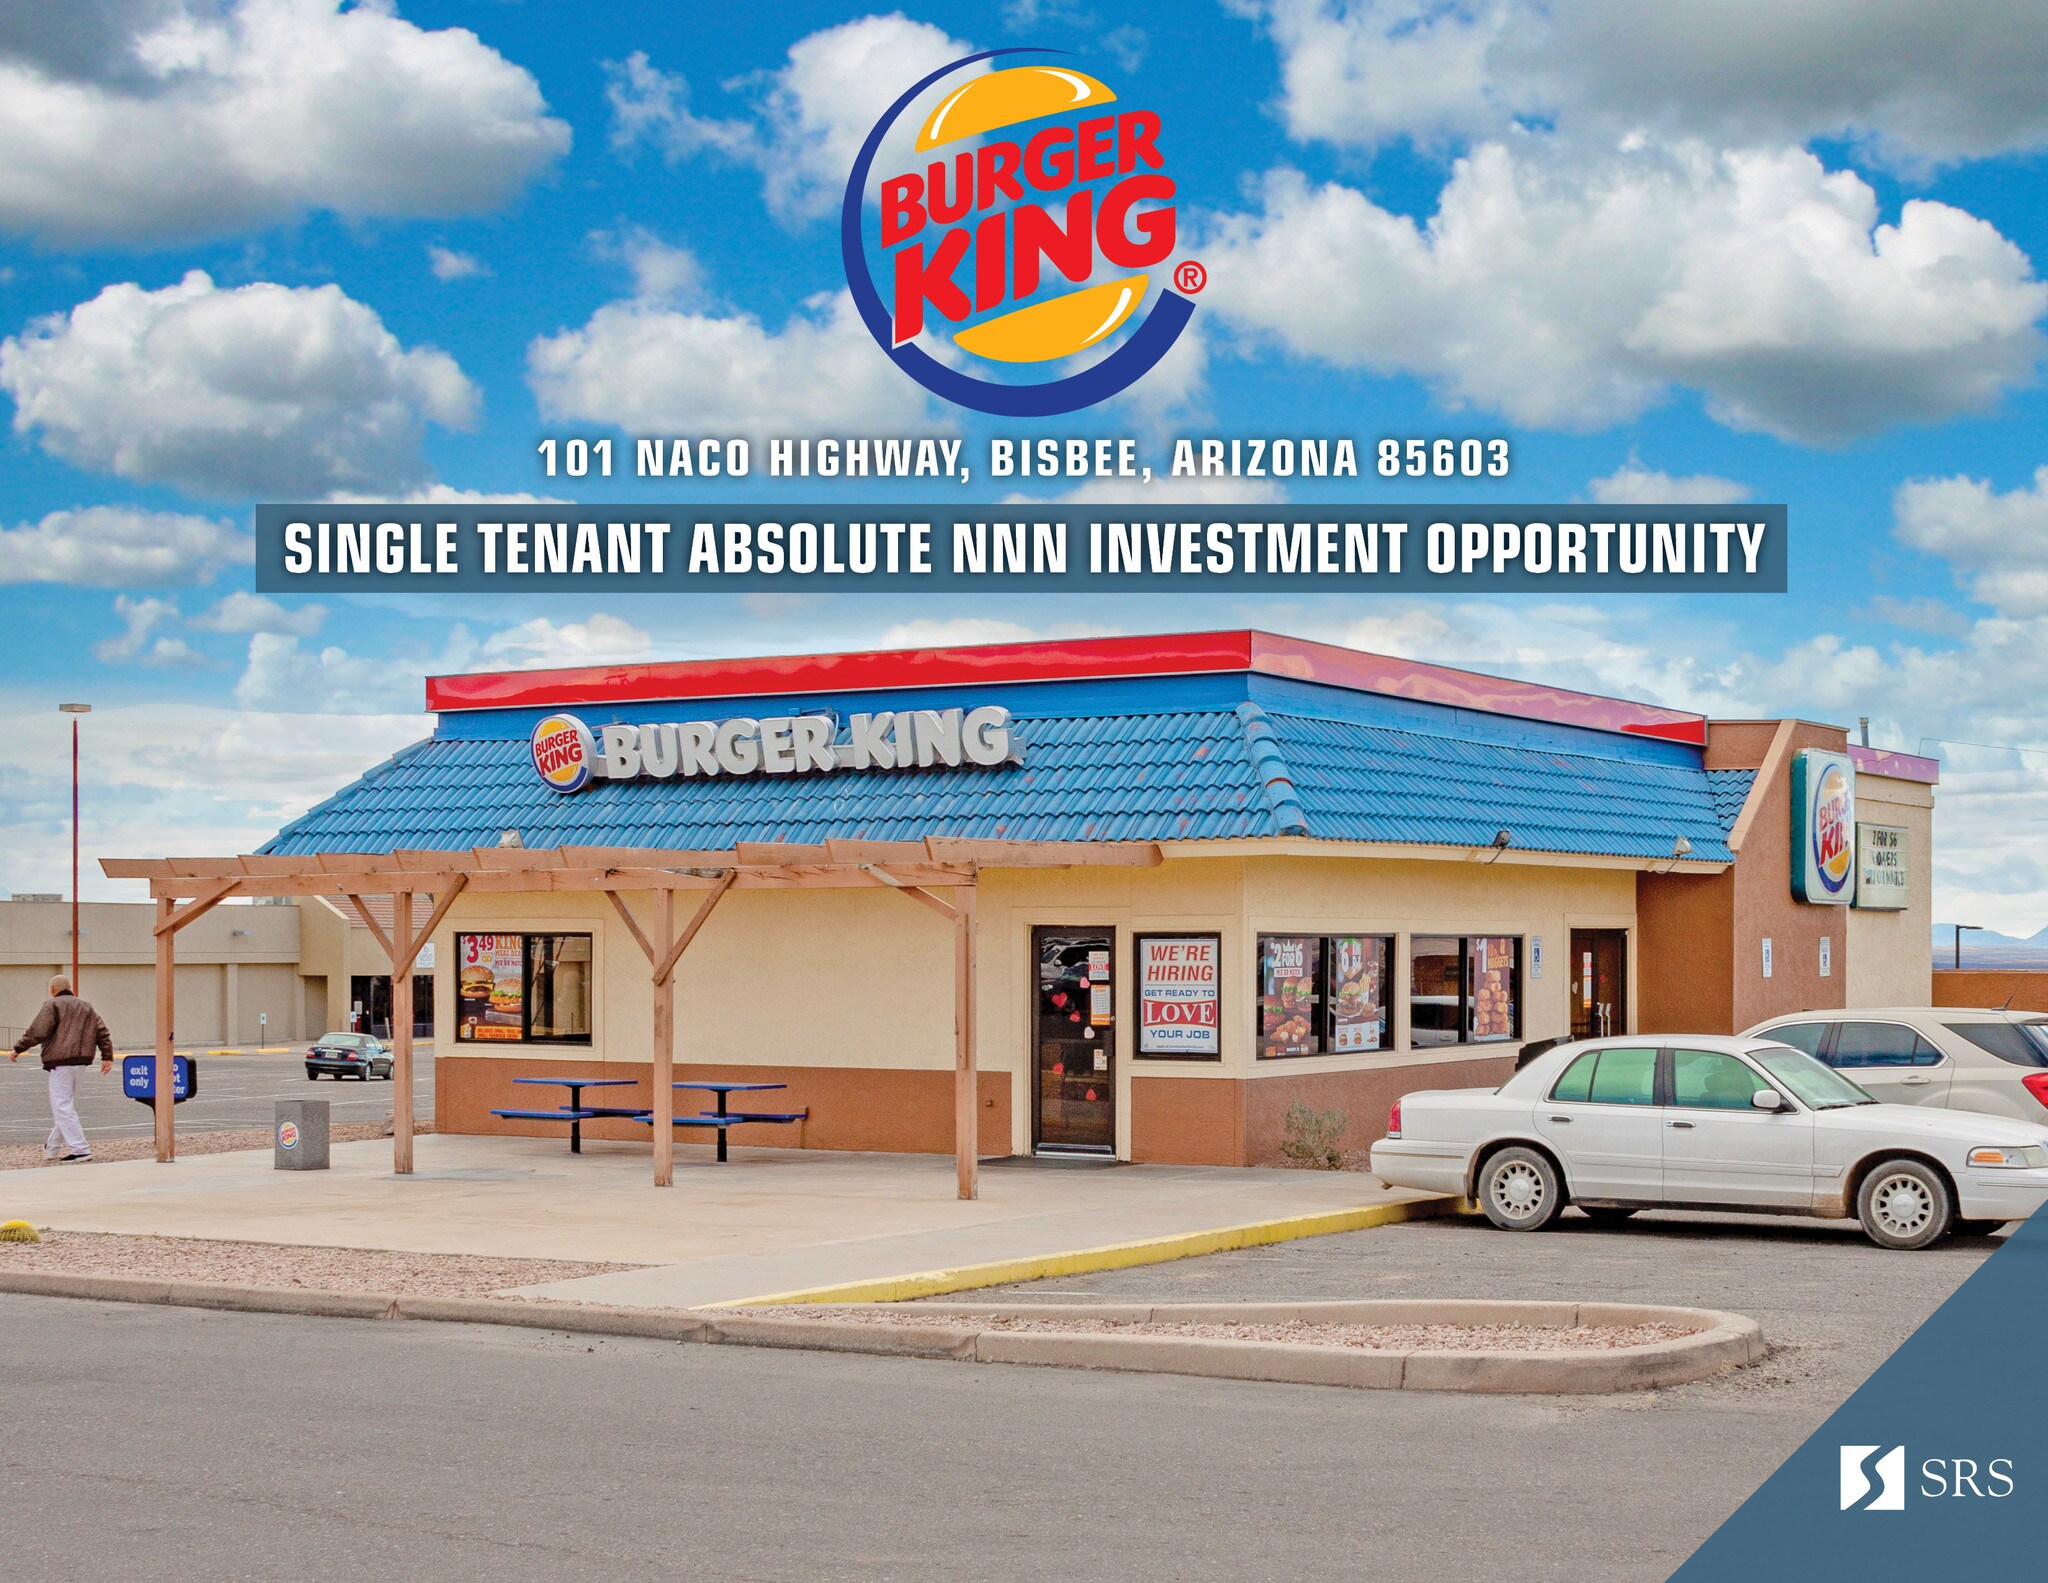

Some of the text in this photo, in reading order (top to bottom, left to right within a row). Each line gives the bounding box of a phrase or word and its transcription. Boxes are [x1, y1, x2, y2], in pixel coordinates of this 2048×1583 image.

[535, 730, 578, 757] BURGER
[602, 705, 1012, 779] BURGER KING
[539, 743, 582, 776] KING
[1151, 945, 1212, 961] WE'RE
[1281, 952, 1295, 967] FOR
[1147, 966, 1214, 981] HIRING
[1145, 1001, 1215, 1025] LOVE
[1150, 1029, 1210, 1039] YOUR JOB
[130, 1065, 148, 1076] exit
[129, 1076, 149, 1089] only
